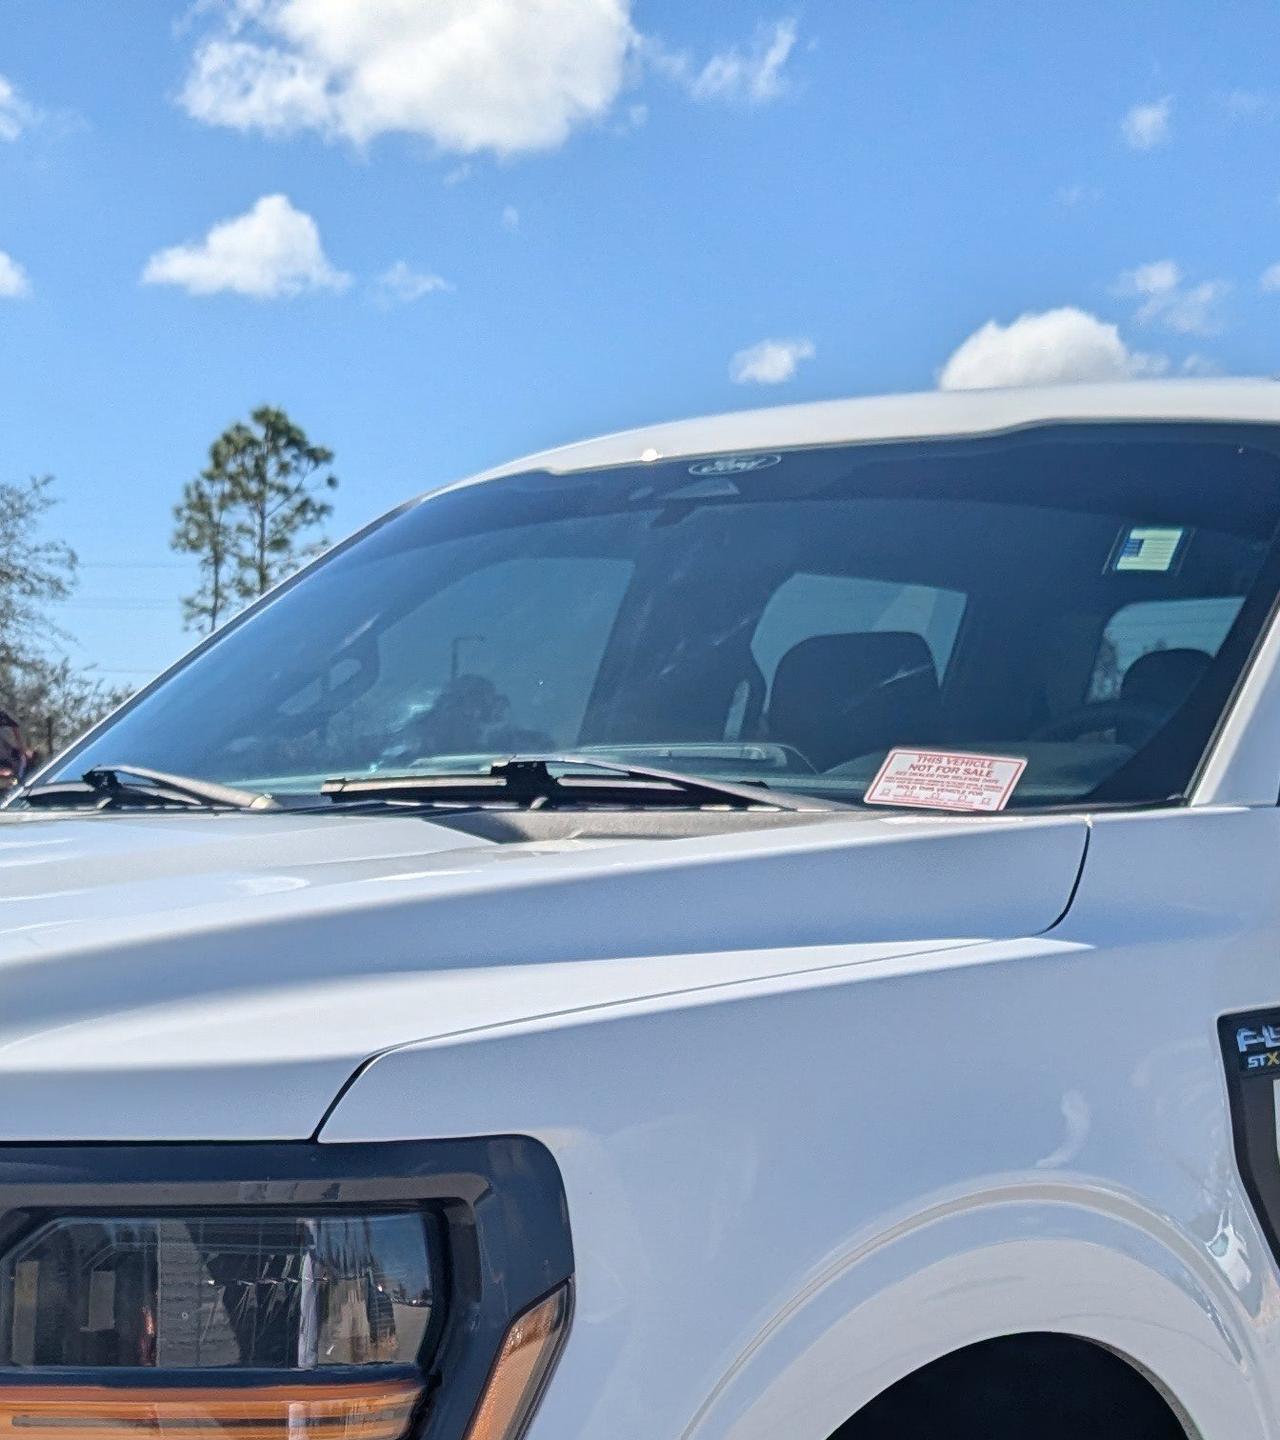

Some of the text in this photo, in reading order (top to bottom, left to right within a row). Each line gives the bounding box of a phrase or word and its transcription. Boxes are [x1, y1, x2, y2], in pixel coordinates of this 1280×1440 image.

[917, 755, 995, 769] THIS VEHICLE
[909, 763, 994, 778] NOT FOR SALE
[1247, 1051, 1280, 1069] STX
